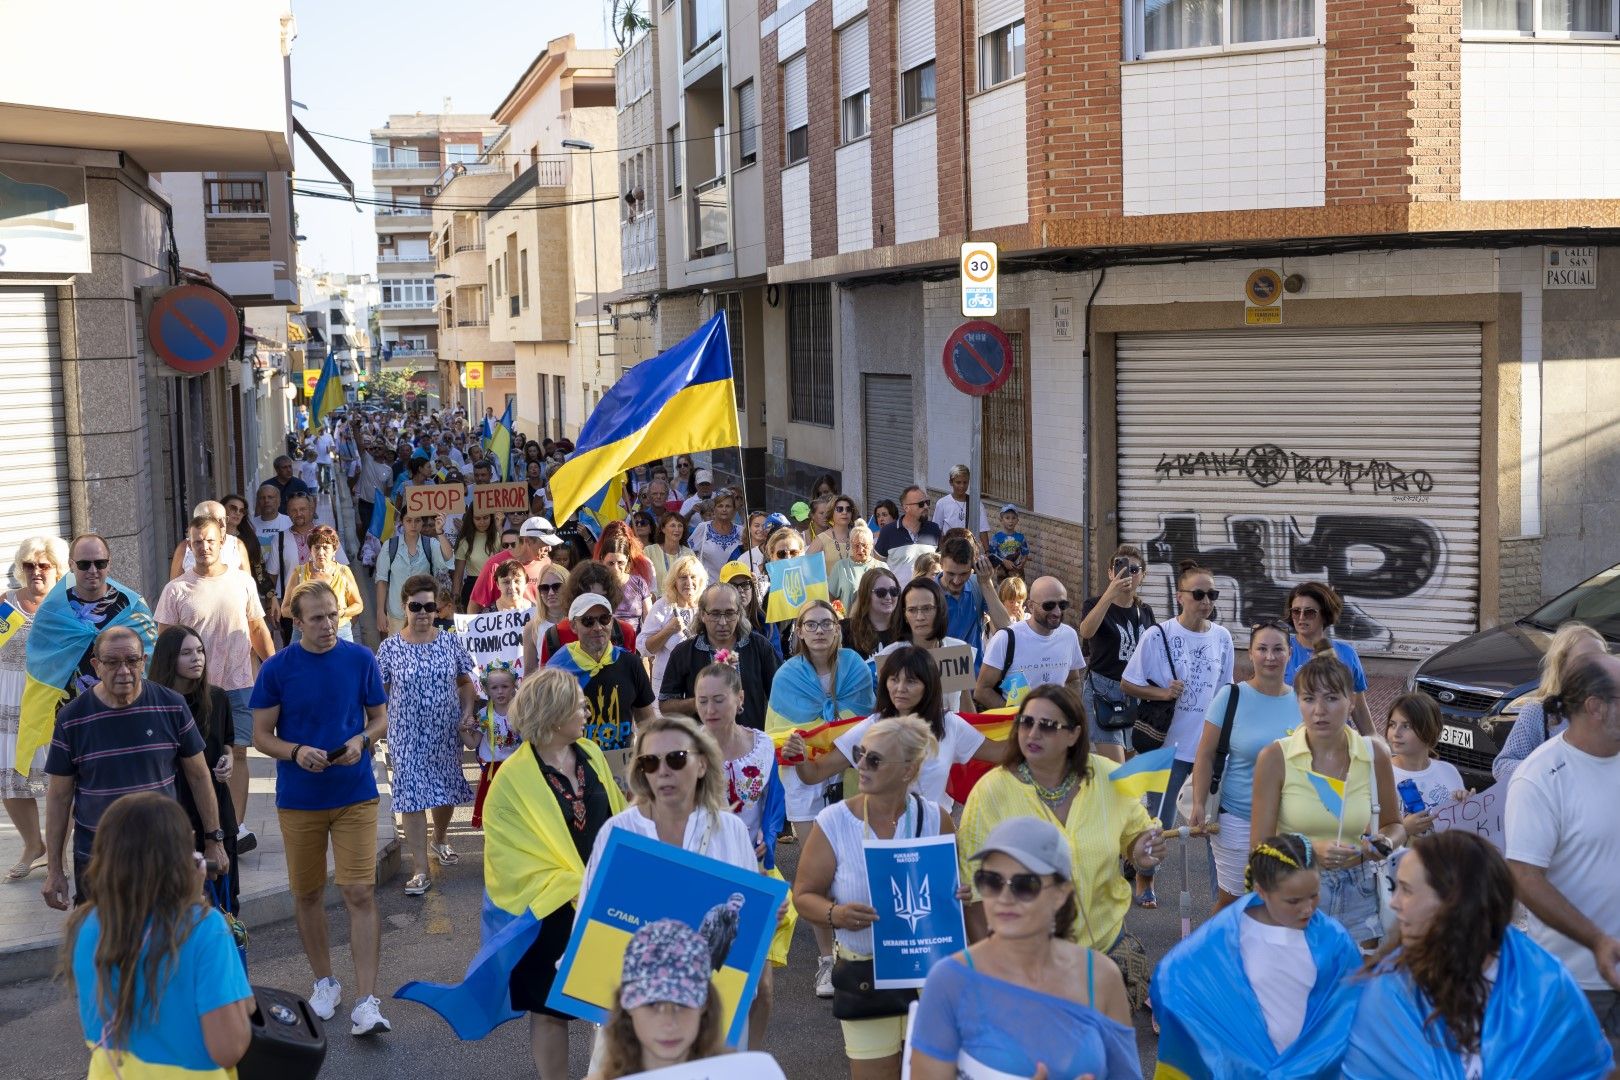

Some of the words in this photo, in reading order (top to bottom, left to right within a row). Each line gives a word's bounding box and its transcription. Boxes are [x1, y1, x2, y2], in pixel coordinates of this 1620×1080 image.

[1564, 248, 1593, 256] CALLE
[971, 261, 989, 272] 30
[1570, 258, 1588, 266] SAN
[1547, 270, 1594, 284] PASCUAL
[410, 490, 460, 512] STOP
[474, 486, 526, 508] TERROR
[457, 619, 470, 632] LA
[474, 612, 531, 632] GUERRA
[1452, 730, 1471, 748] FZM
[1436, 794, 1495, 829] STOP
[608, 908, 640, 926] СЛАВА
[918, 936, 952, 944] WELCOME
